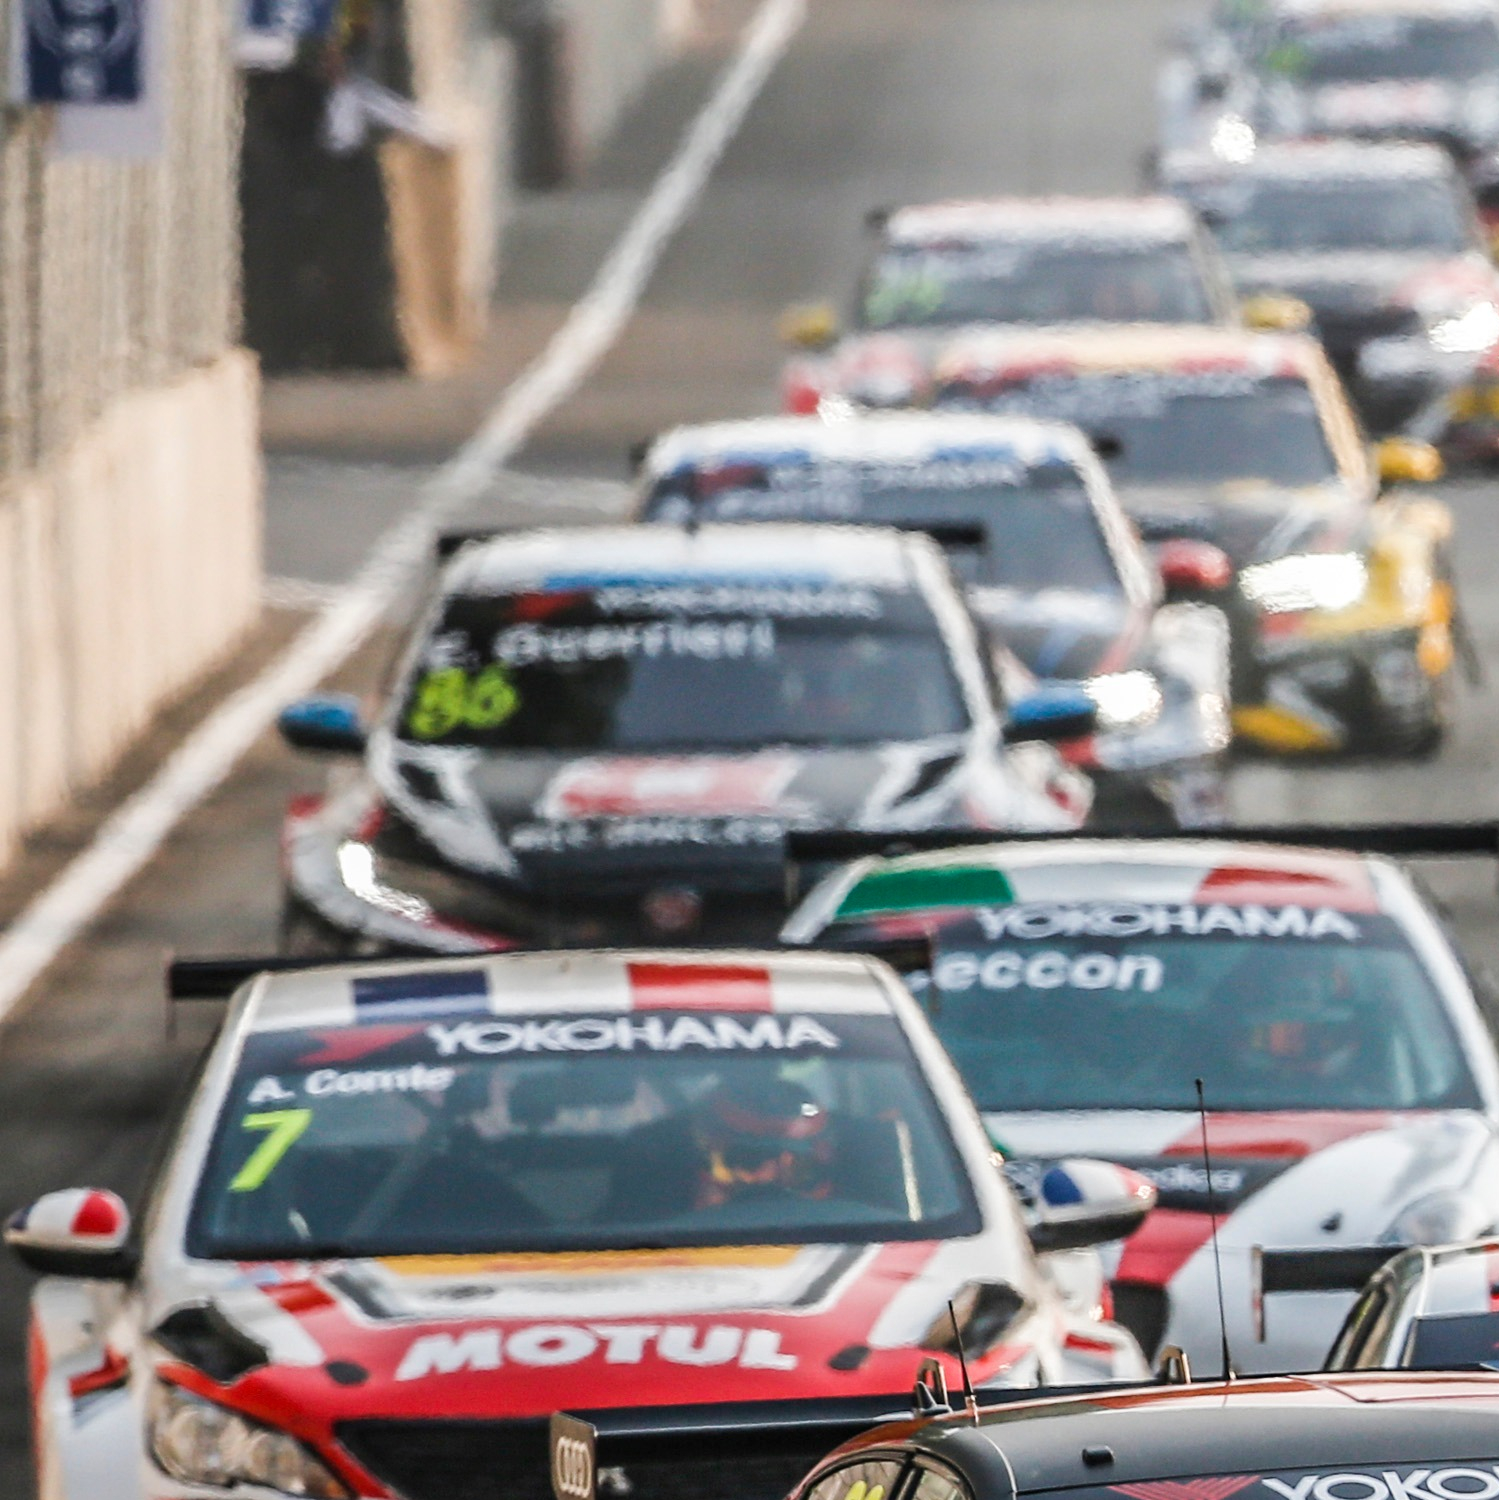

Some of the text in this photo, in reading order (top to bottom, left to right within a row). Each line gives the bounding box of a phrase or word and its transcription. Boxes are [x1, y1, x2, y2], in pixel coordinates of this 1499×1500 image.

[975, 903, 1361, 940] YOKOHAMA
[905, 951, 1164, 992] eccon
[427, 1015, 840, 1056] YOKOHAMA
[305, 1063, 457, 1098] Comte
[228, 1108, 312, 1192] 7
[396, 1323, 799, 1382] MOTUL
